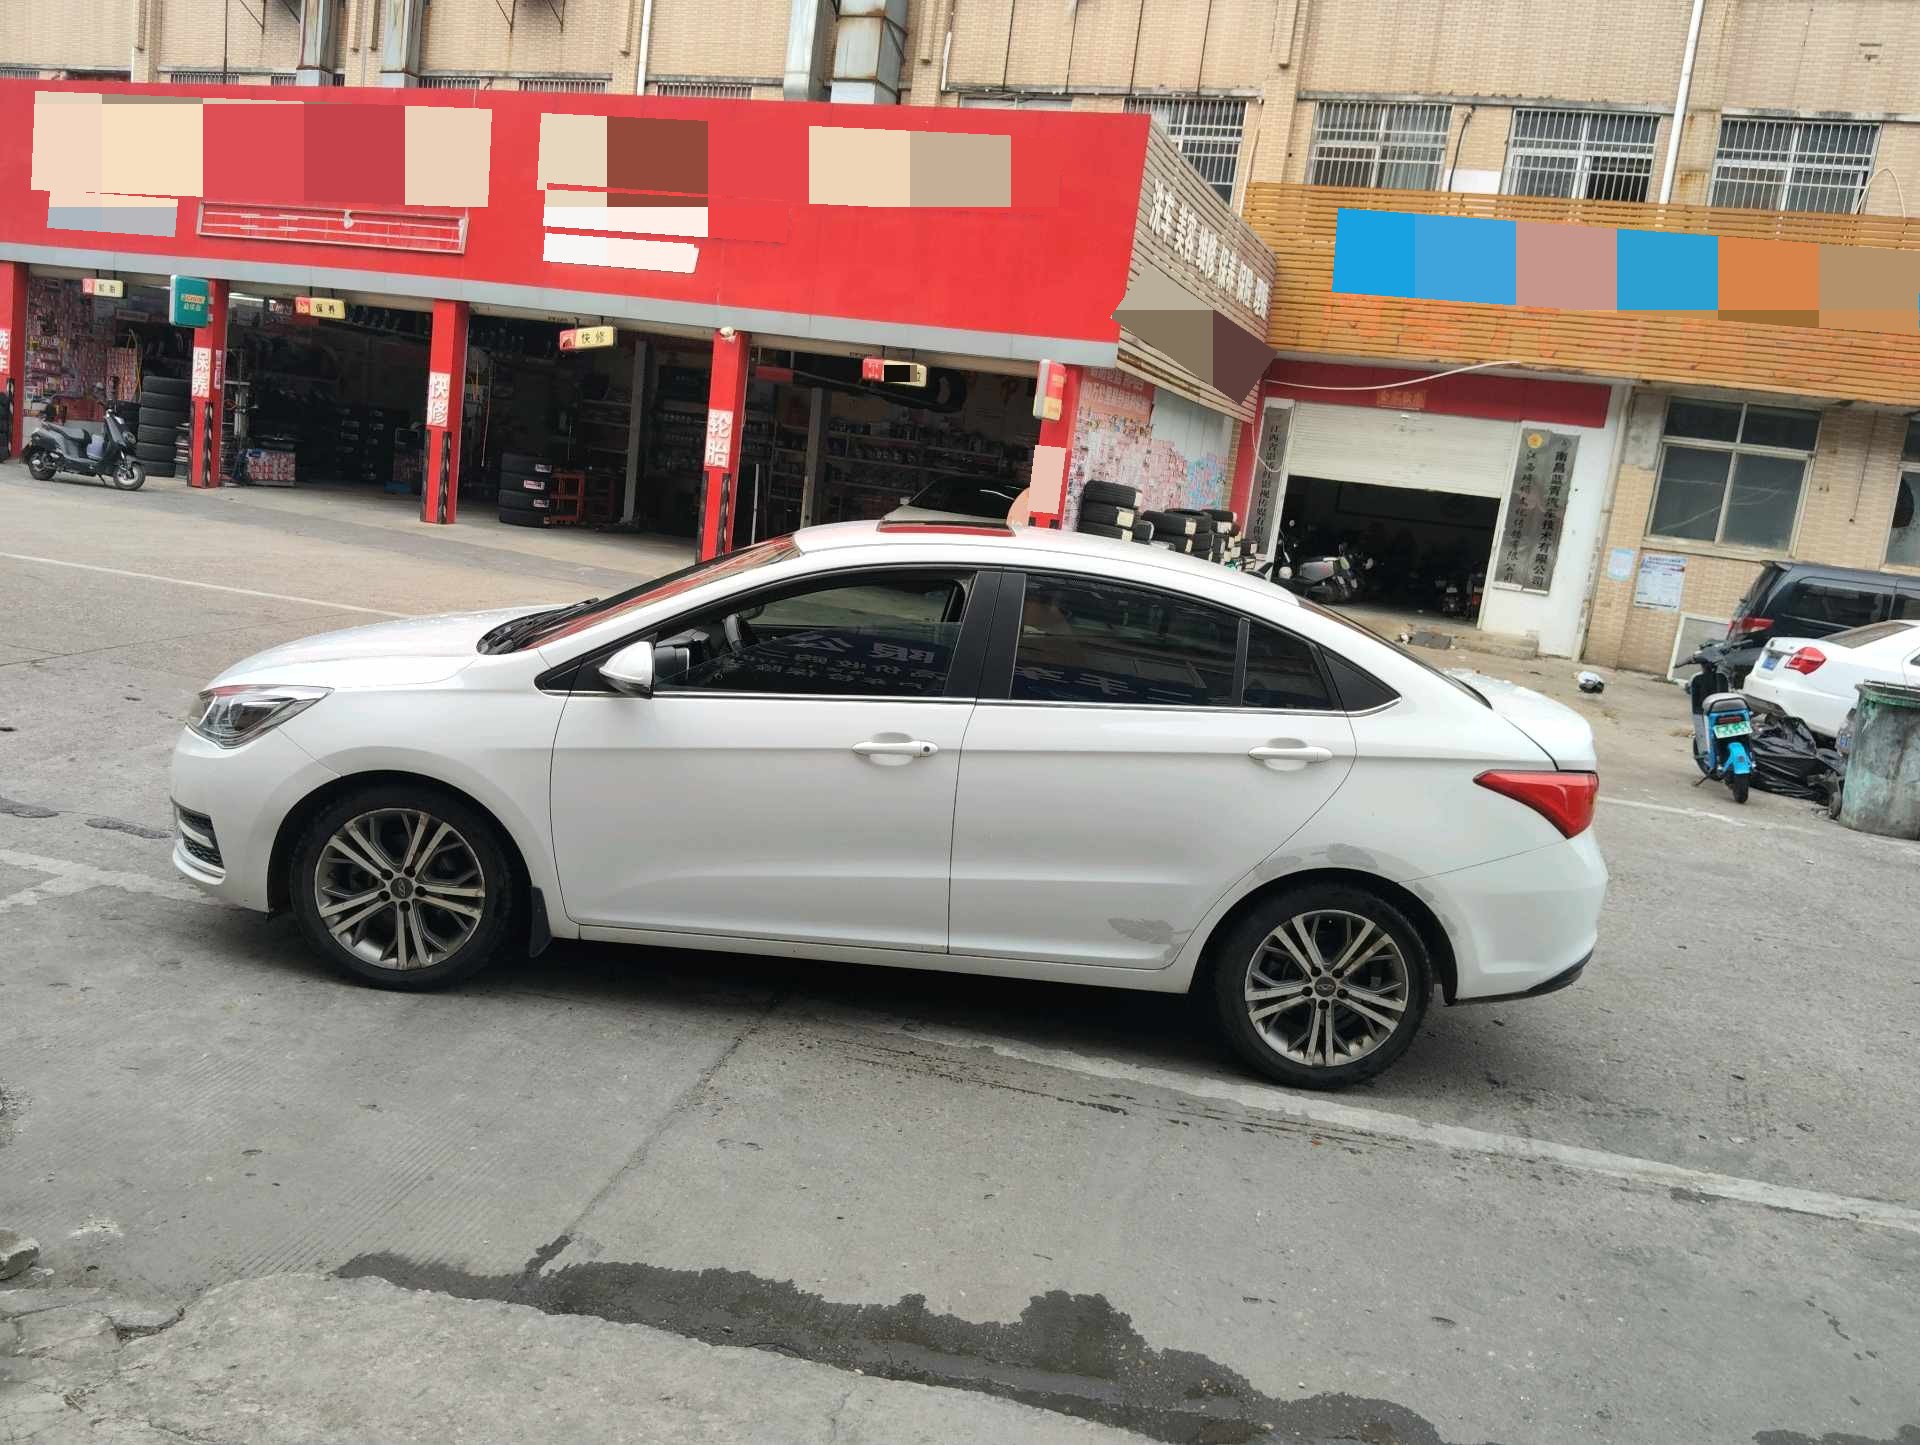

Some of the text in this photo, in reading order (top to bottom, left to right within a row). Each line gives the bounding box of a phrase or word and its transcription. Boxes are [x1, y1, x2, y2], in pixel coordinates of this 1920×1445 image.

[193, 349, 210, 396] 保养
[428, 373, 449, 425] 快修
[706, 411, 732, 466] 轮胎
